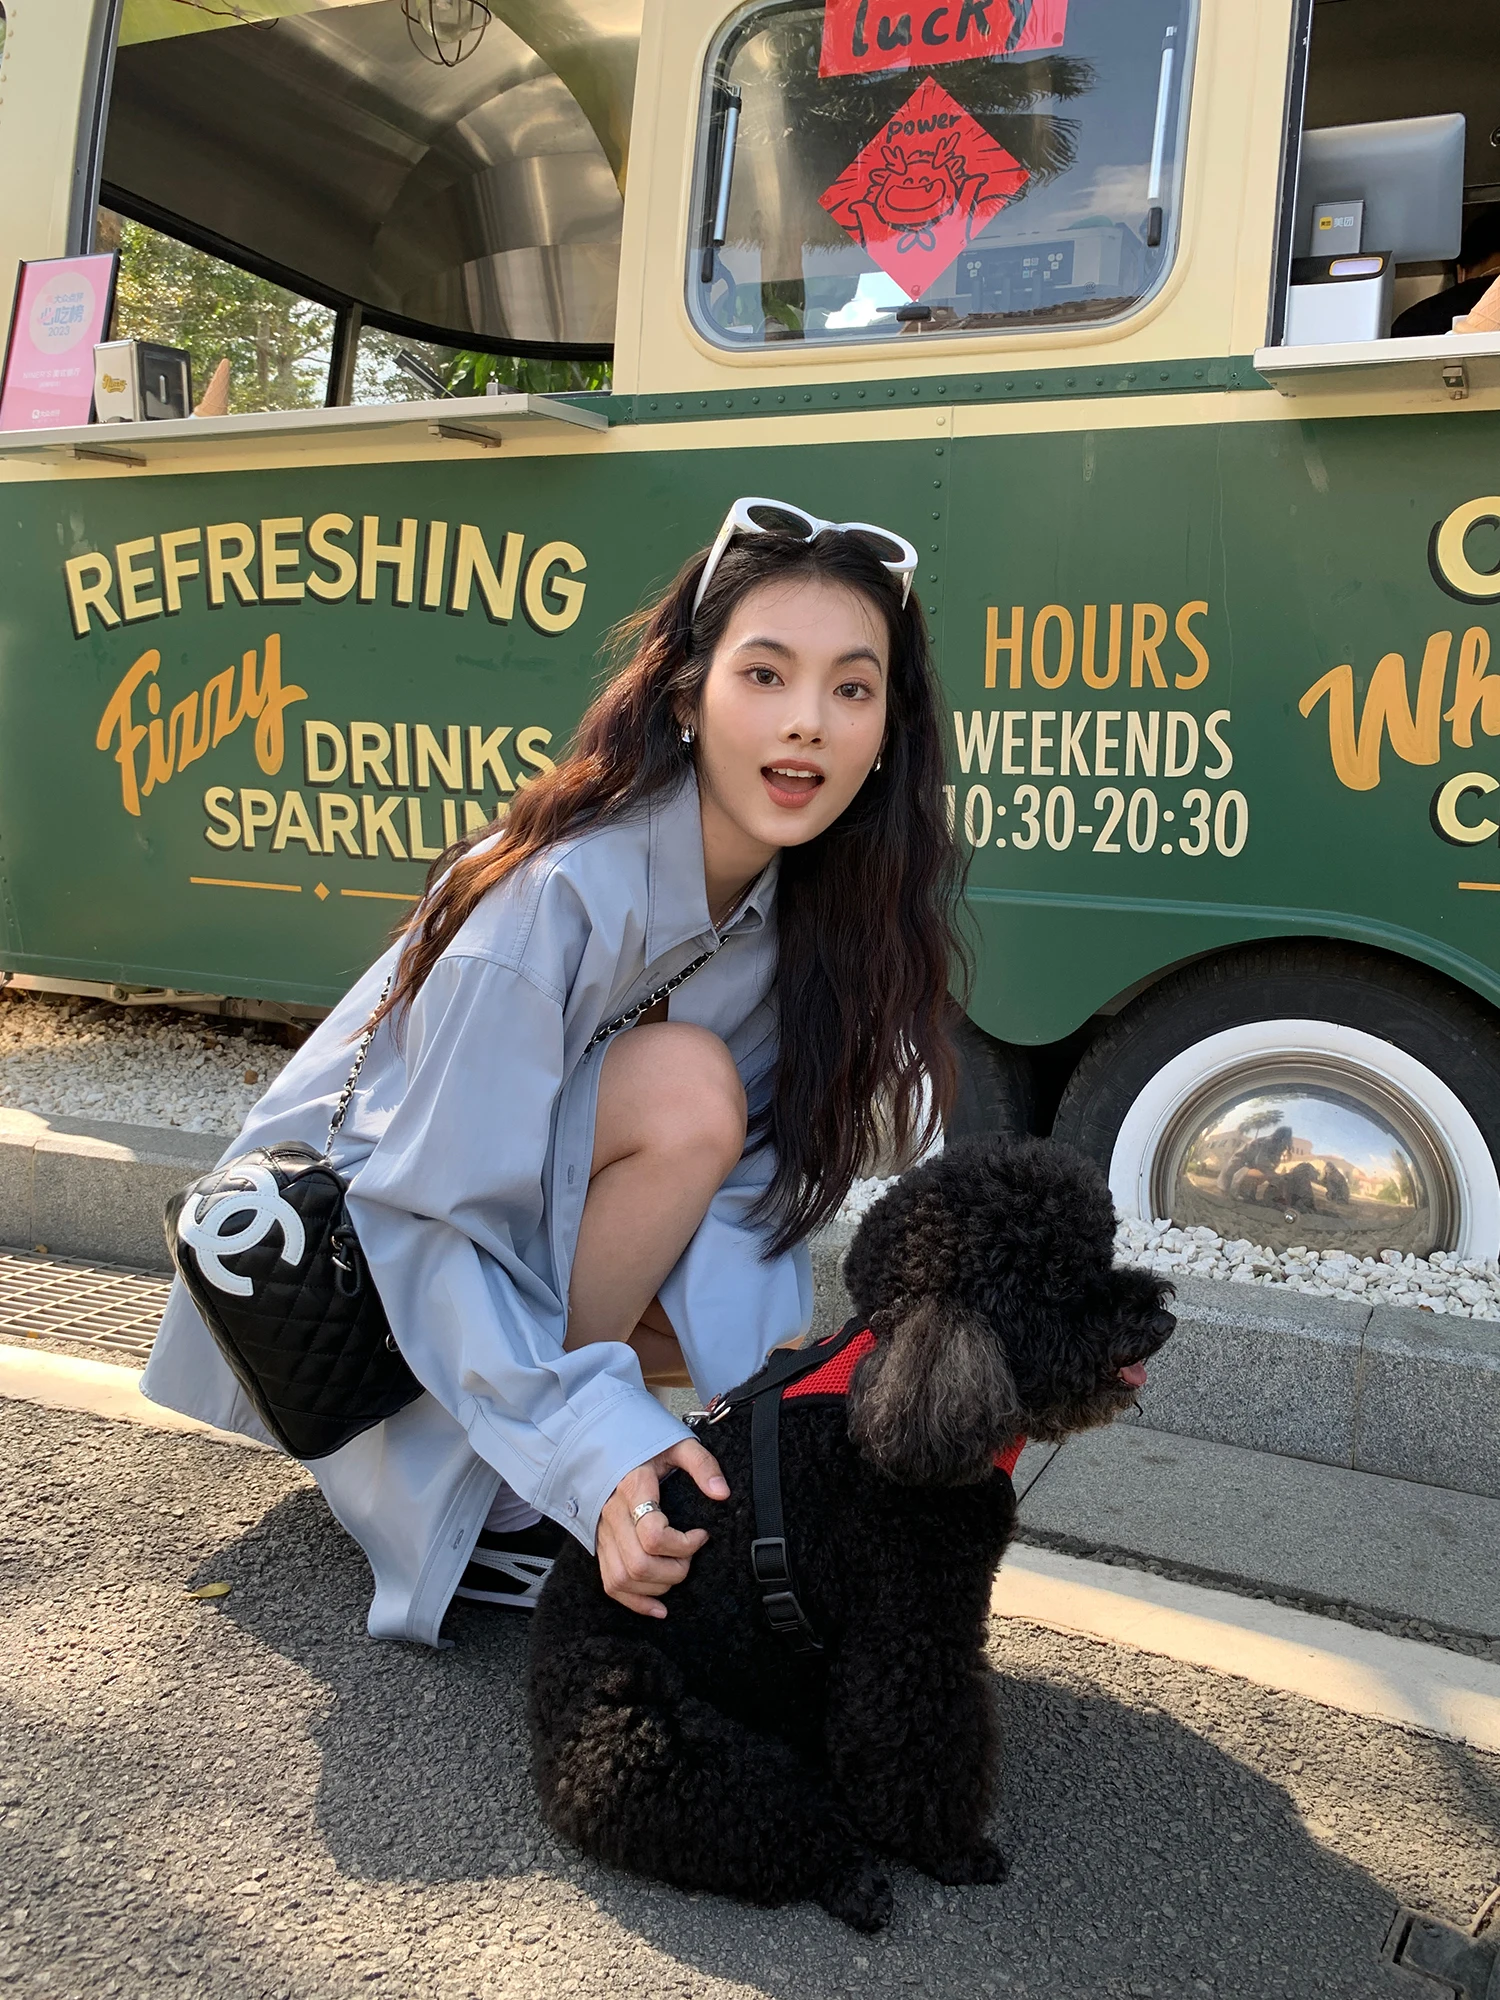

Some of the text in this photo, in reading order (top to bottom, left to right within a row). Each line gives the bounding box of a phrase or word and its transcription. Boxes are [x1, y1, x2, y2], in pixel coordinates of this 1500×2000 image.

[886, 112, 963, 144] power
[48, 325, 71, 337] 2023
[64, 512, 588, 637] REFRESHING
[984, 600, 1210, 690] HOURS
[96, 633, 308, 816] Fizzy
[303, 720, 556, 796] DRINKS
[953, 709, 1233, 780] WEEKENDS
[943, 784, 1249, 857] 10:30-20:30
